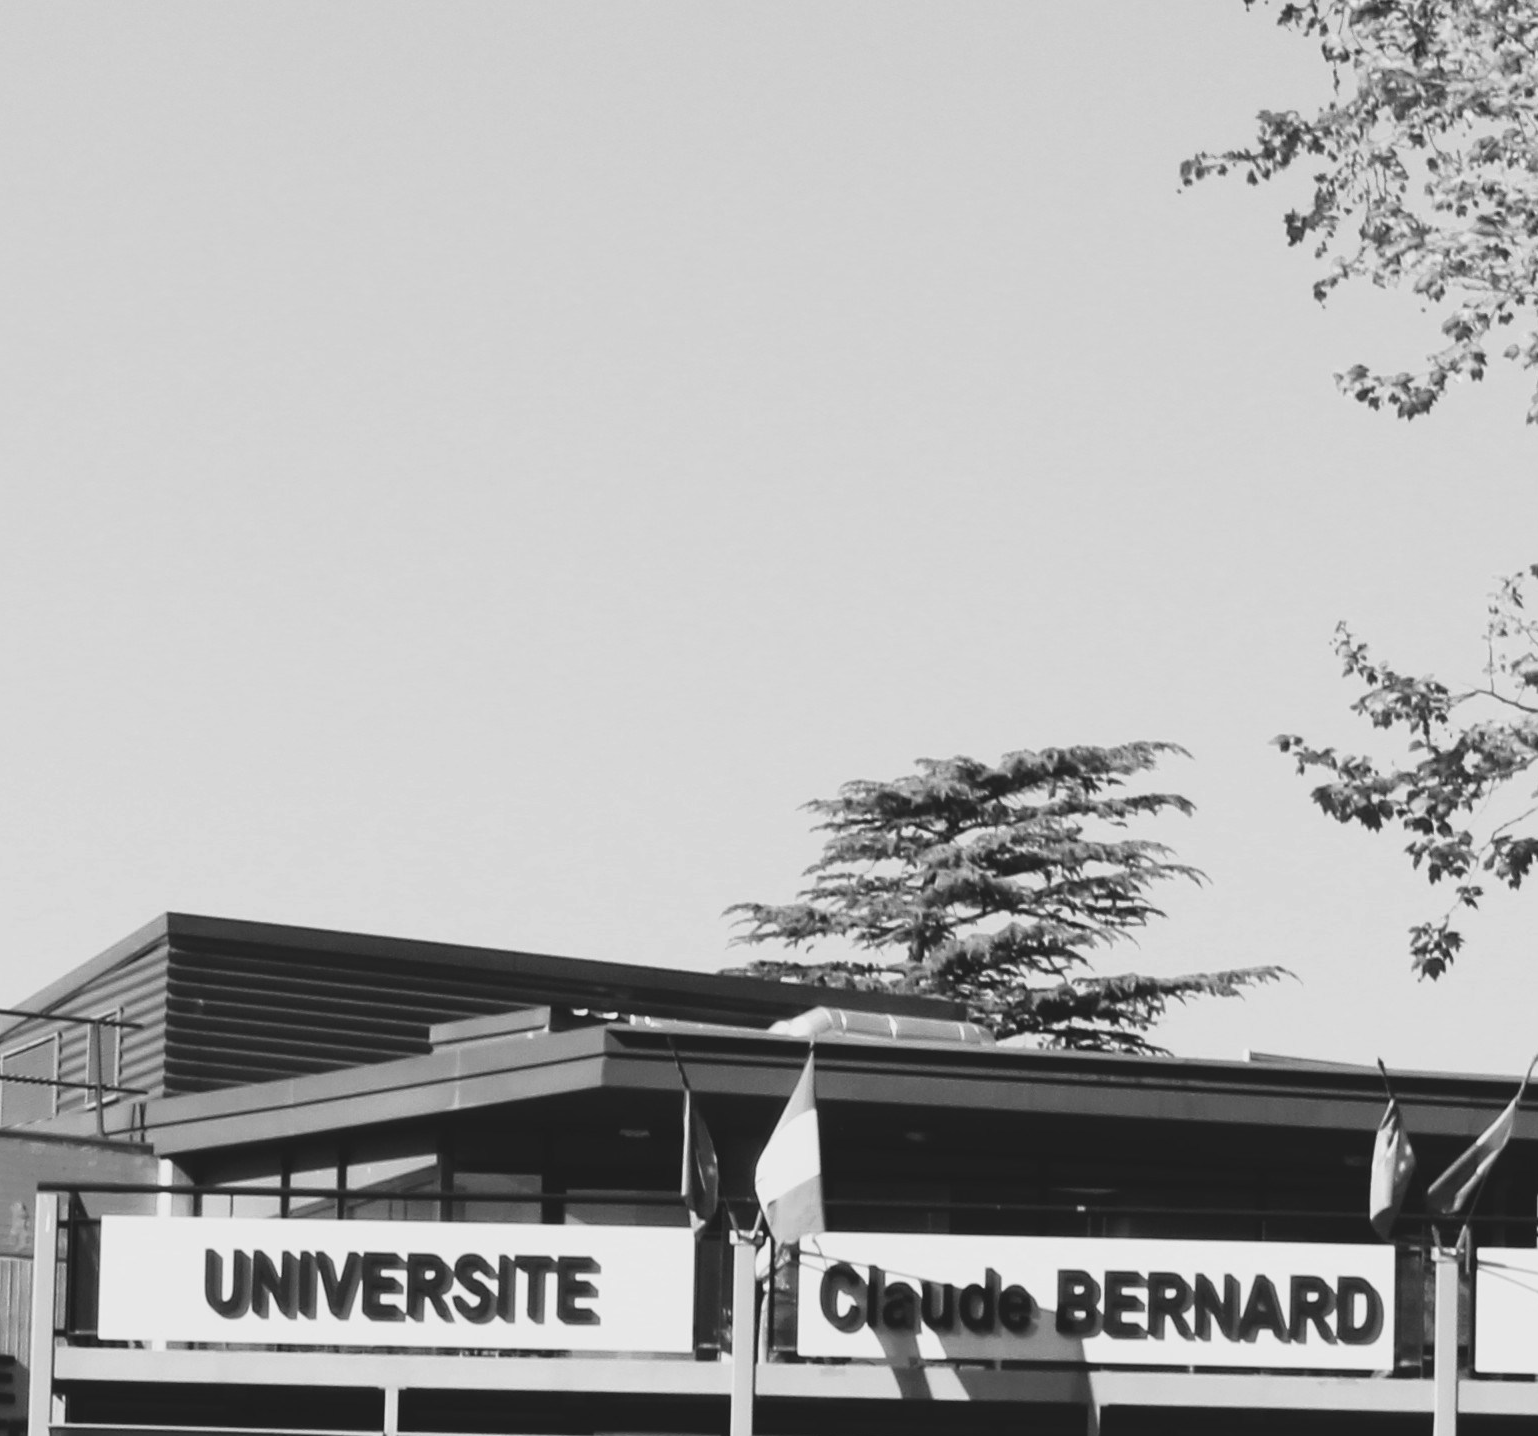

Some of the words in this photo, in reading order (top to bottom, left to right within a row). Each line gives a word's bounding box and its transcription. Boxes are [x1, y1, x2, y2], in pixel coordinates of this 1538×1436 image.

[204, 1248, 601, 1326] UNIVERSITE
[818, 1260, 1040, 1336] Claude
[1055, 1267, 1385, 1346] BERNARD
